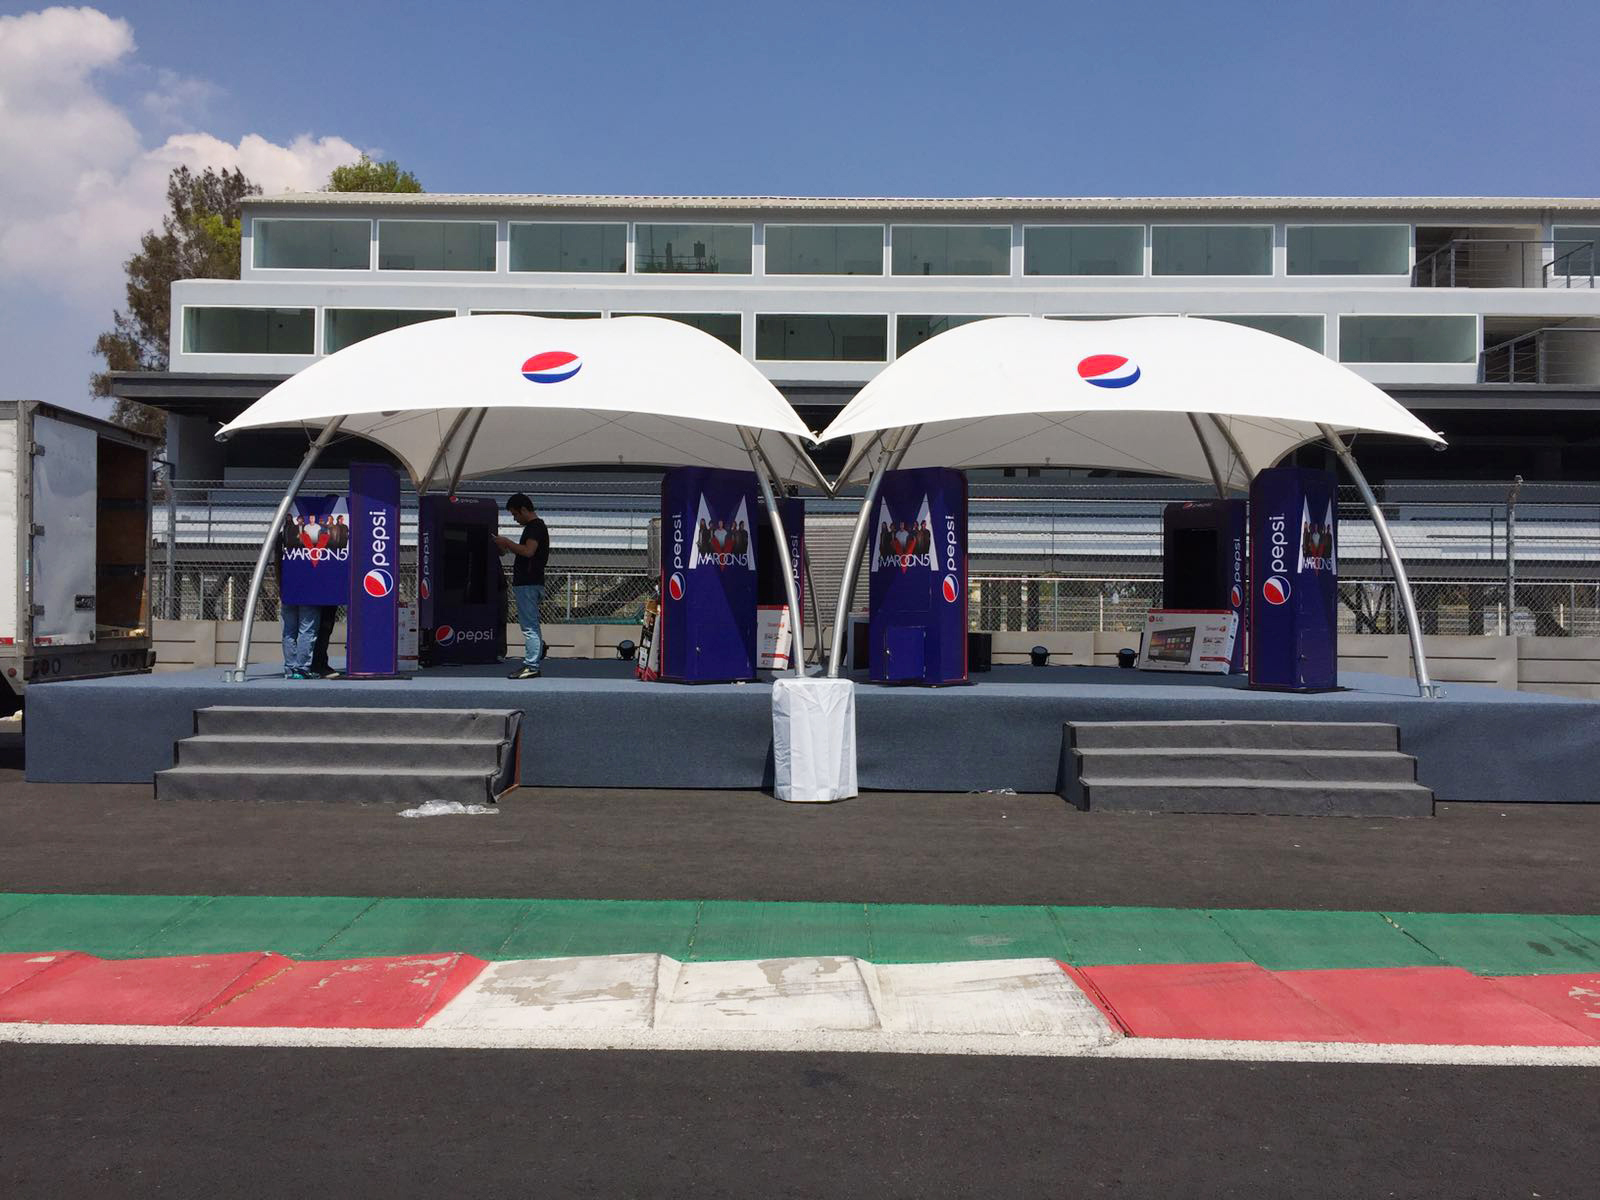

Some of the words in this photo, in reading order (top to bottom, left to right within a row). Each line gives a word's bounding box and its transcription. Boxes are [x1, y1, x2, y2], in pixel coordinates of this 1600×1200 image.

[369, 511, 390, 566] pepsi
[422, 532, 430, 575] pepsi
[672, 514, 684, 569] pepsi
[945, 515, 957, 571] pepsi
[1233, 538, 1242, 582] pepsi
[1269, 516, 1288, 573] pepsi
[457, 628, 493, 643] pepsi
